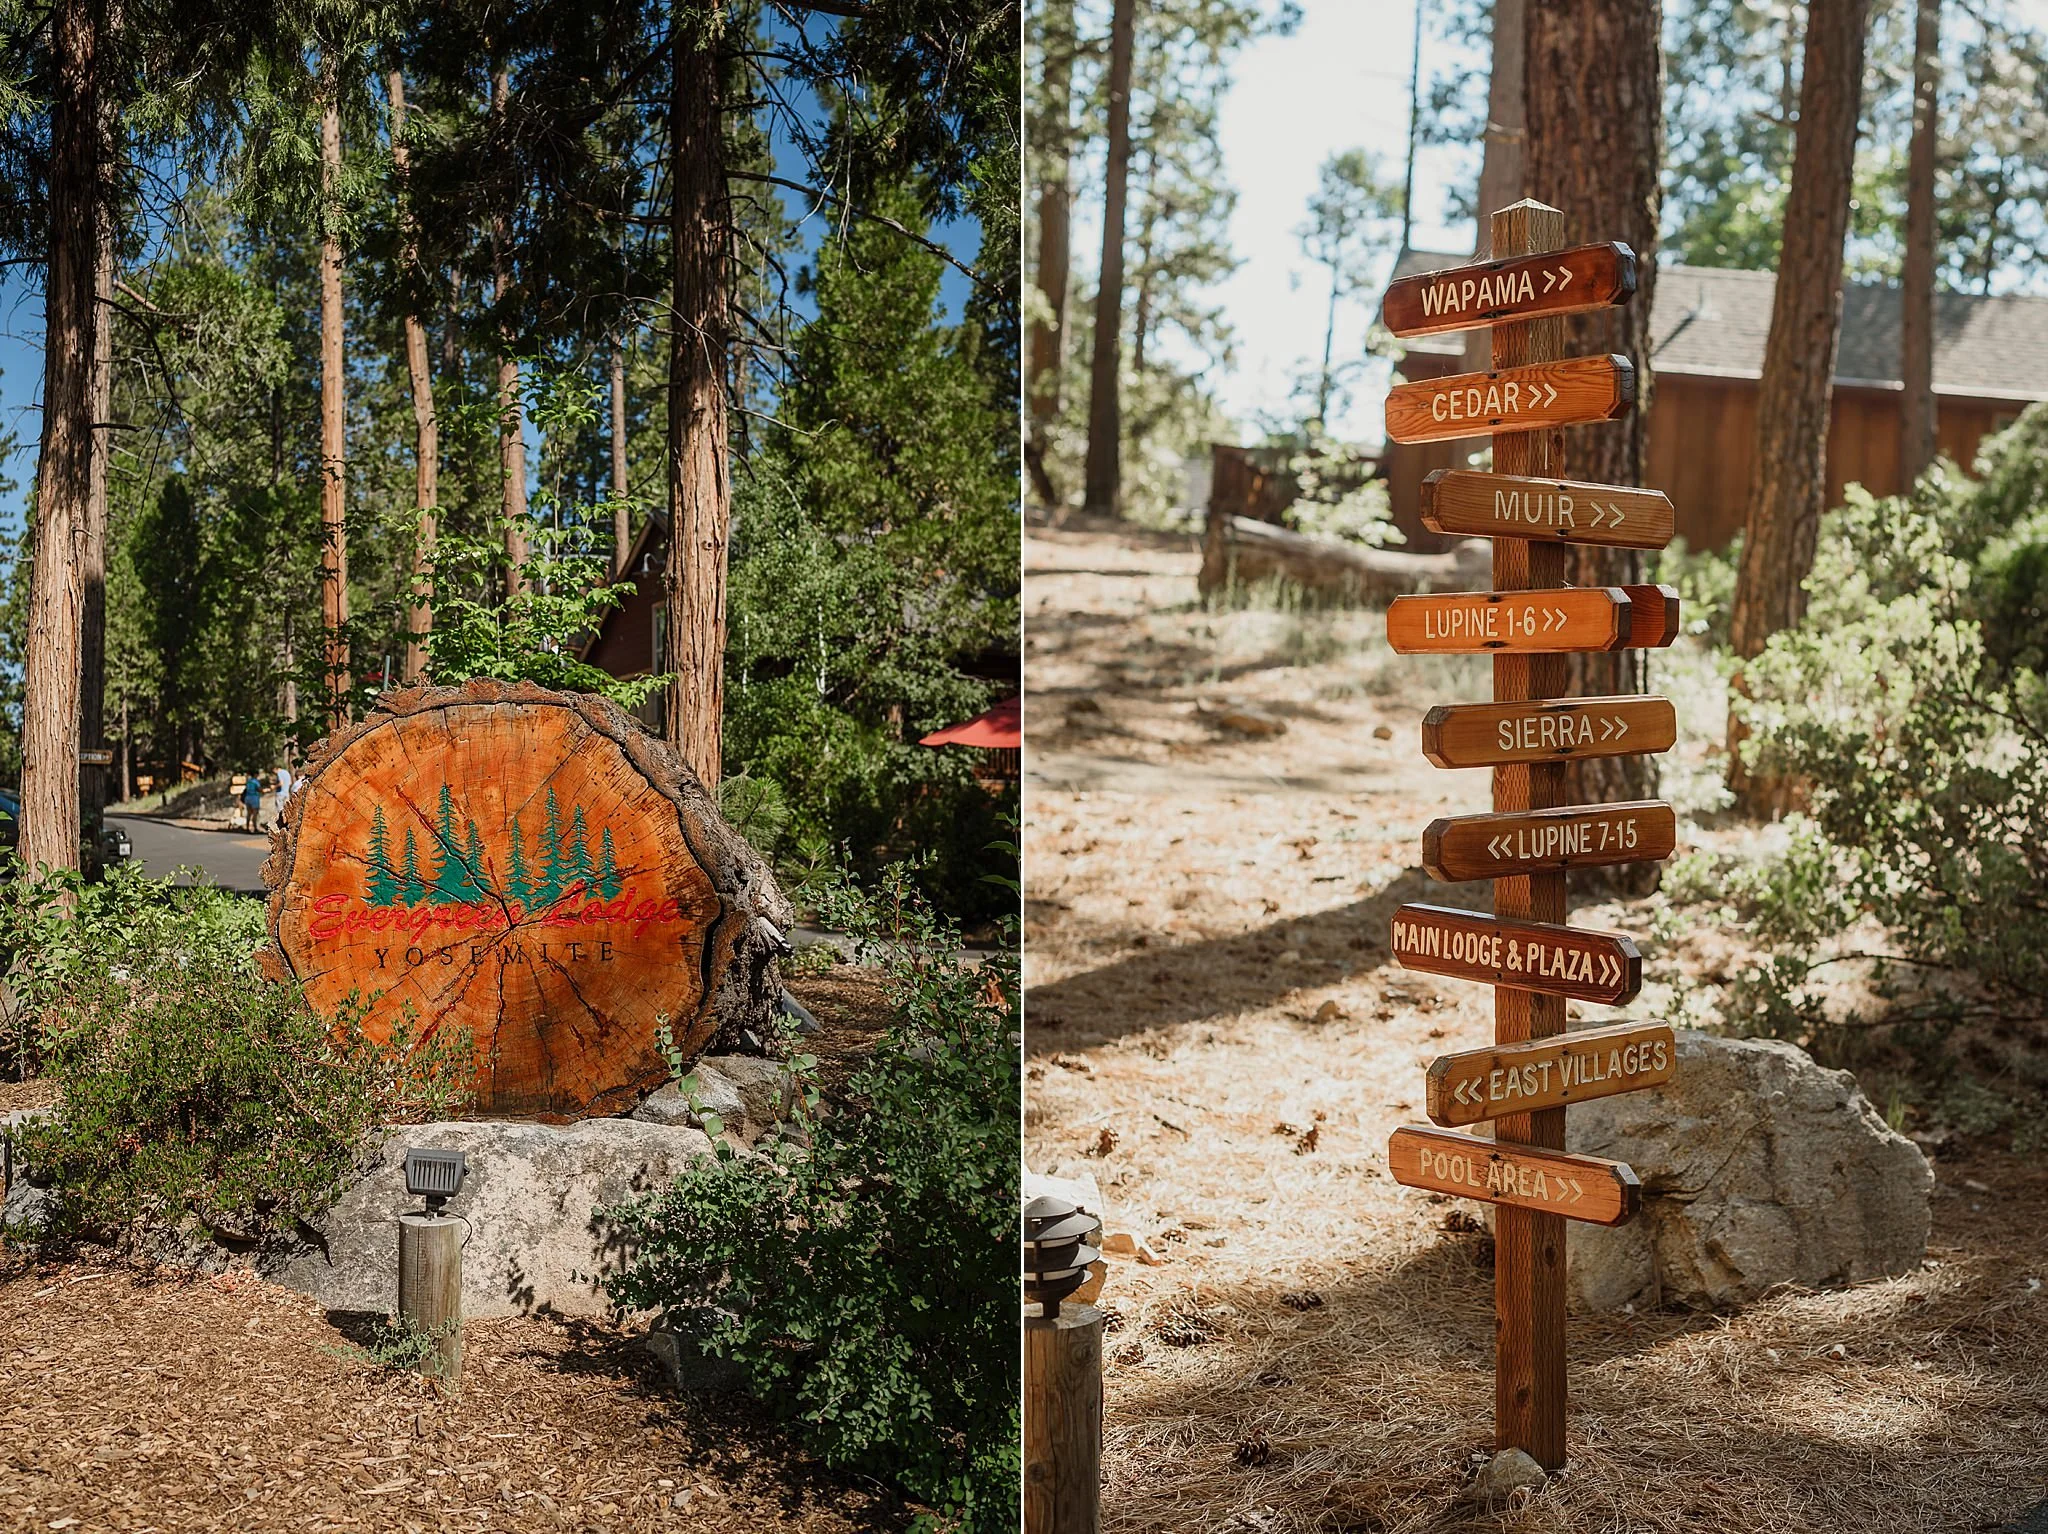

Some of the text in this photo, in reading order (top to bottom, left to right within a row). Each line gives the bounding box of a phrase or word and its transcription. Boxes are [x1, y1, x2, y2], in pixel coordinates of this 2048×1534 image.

[1421, 270, 1535, 316] WAPAMA
[1432, 382, 1519, 421] CEDAR
[1495, 490, 1575, 527] MUIR
[1425, 606, 1536, 639] LUPINE 1-6
[1498, 714, 1594, 750] SIERRA
[1518, 819, 1638, 859] LUPINE 7-15
[309, 879, 681, 945] Evergreen Lodge
[374, 942, 614, 968] YOSEMITE
[1393, 922, 1594, 983] MAIN LODGE & PLAZA
[1490, 1040, 1668, 1100] EAST VILLAGES
[1420, 1148, 1549, 1200] POOL AREA
